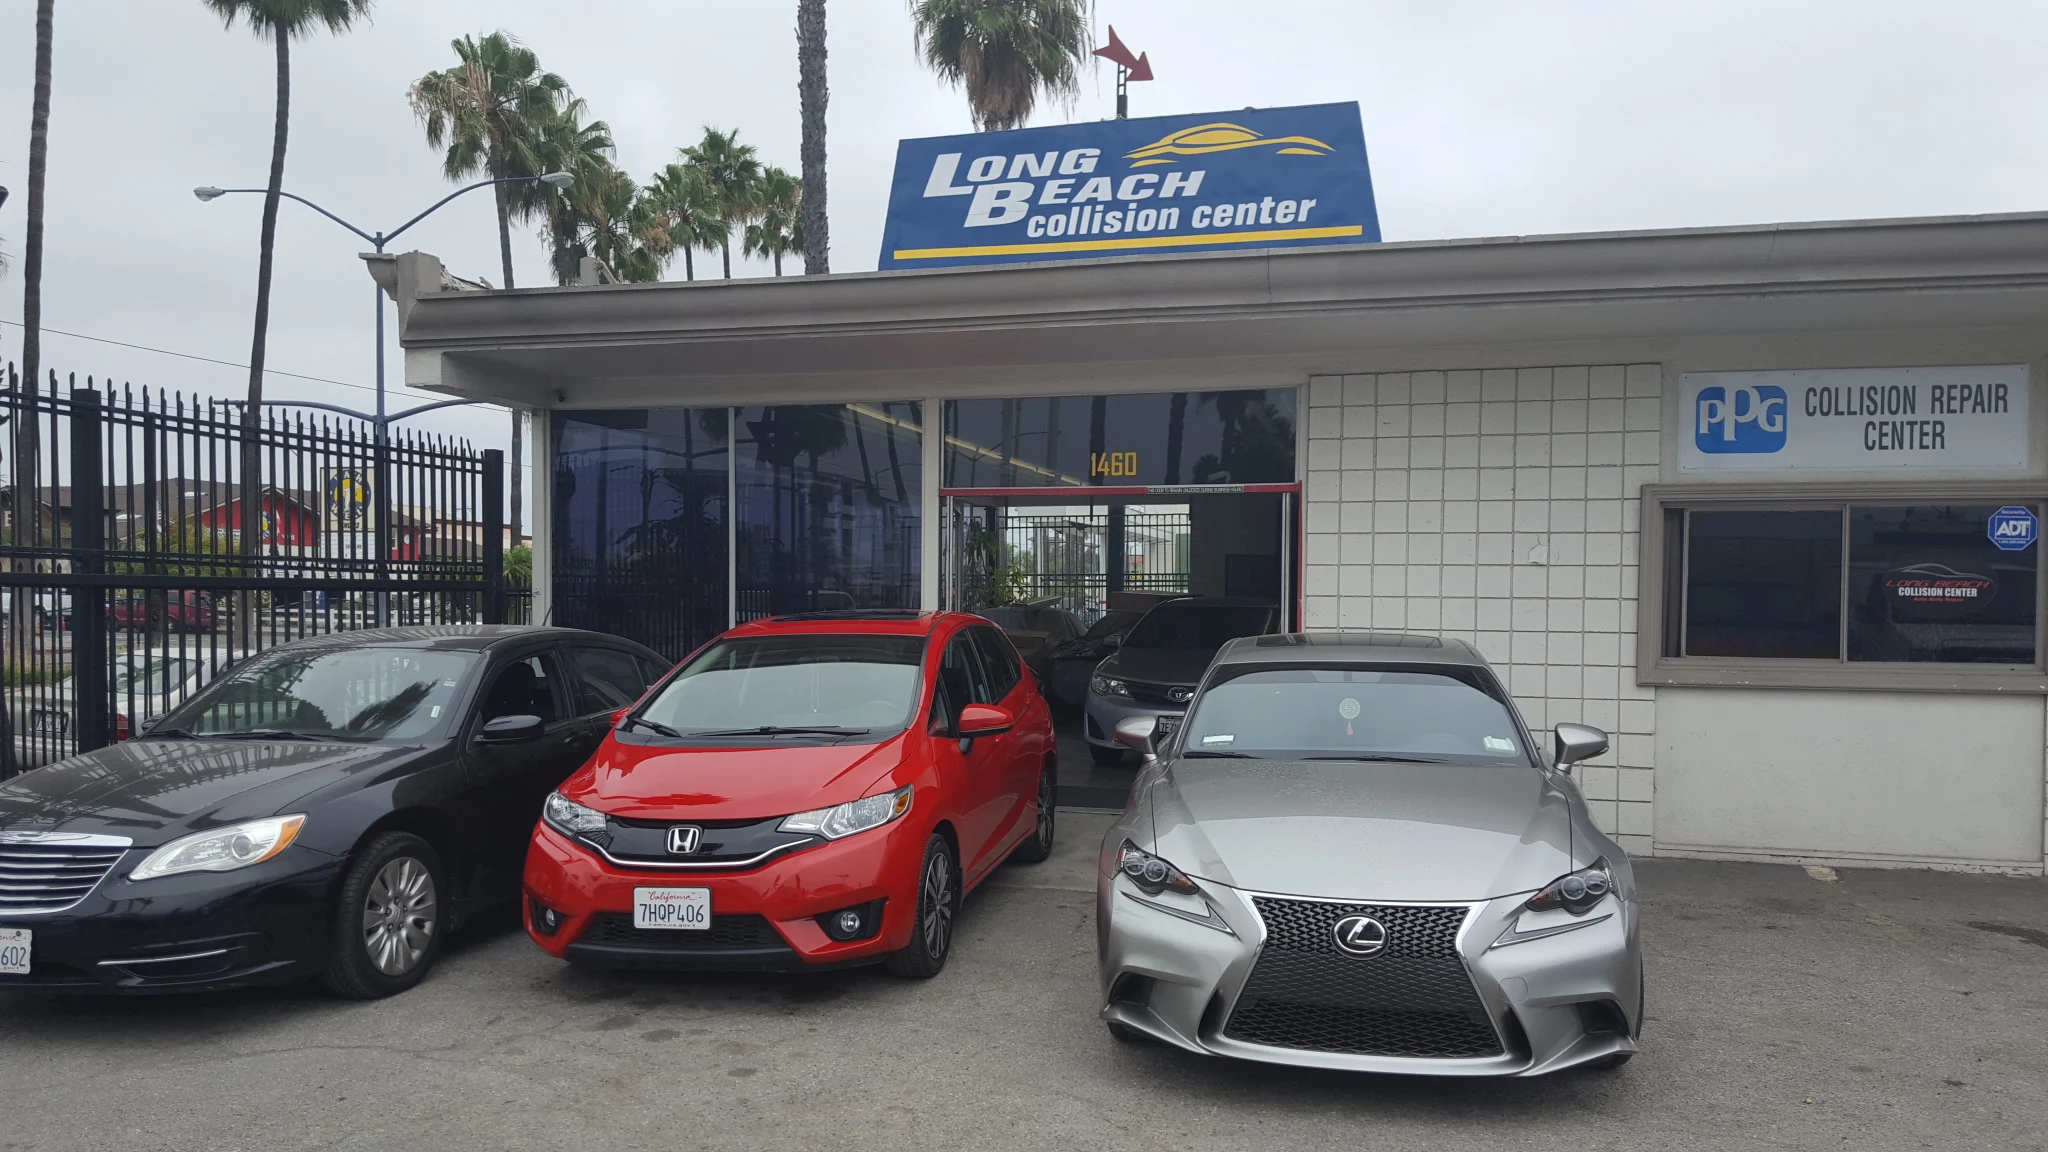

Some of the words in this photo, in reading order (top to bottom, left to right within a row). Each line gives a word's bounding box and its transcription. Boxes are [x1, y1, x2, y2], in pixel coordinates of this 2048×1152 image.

[923, 147, 1101, 198] LONG
[963, 170, 1207, 229] BEACH
[1026, 206, 1181, 239] collision
[1191, 195, 1318, 230] center
[1699, 386, 1784, 441] PPG
[1804, 386, 1917, 417] COLLISION
[1930, 383, 2009, 414] REPAIR
[1863, 420, 1946, 451] CENTER
[1090, 452, 1137, 477] 1460
[1996, 520, 2030, 536] ADT
[1898, 587, 1943, 597] COLLISION
[1944, 588, 1978, 597] CENTER
[1933, 580, 1990, 588] BEACH
[649, 891, 695, 903] California
[639, 904, 704, 923] 7HQP406
